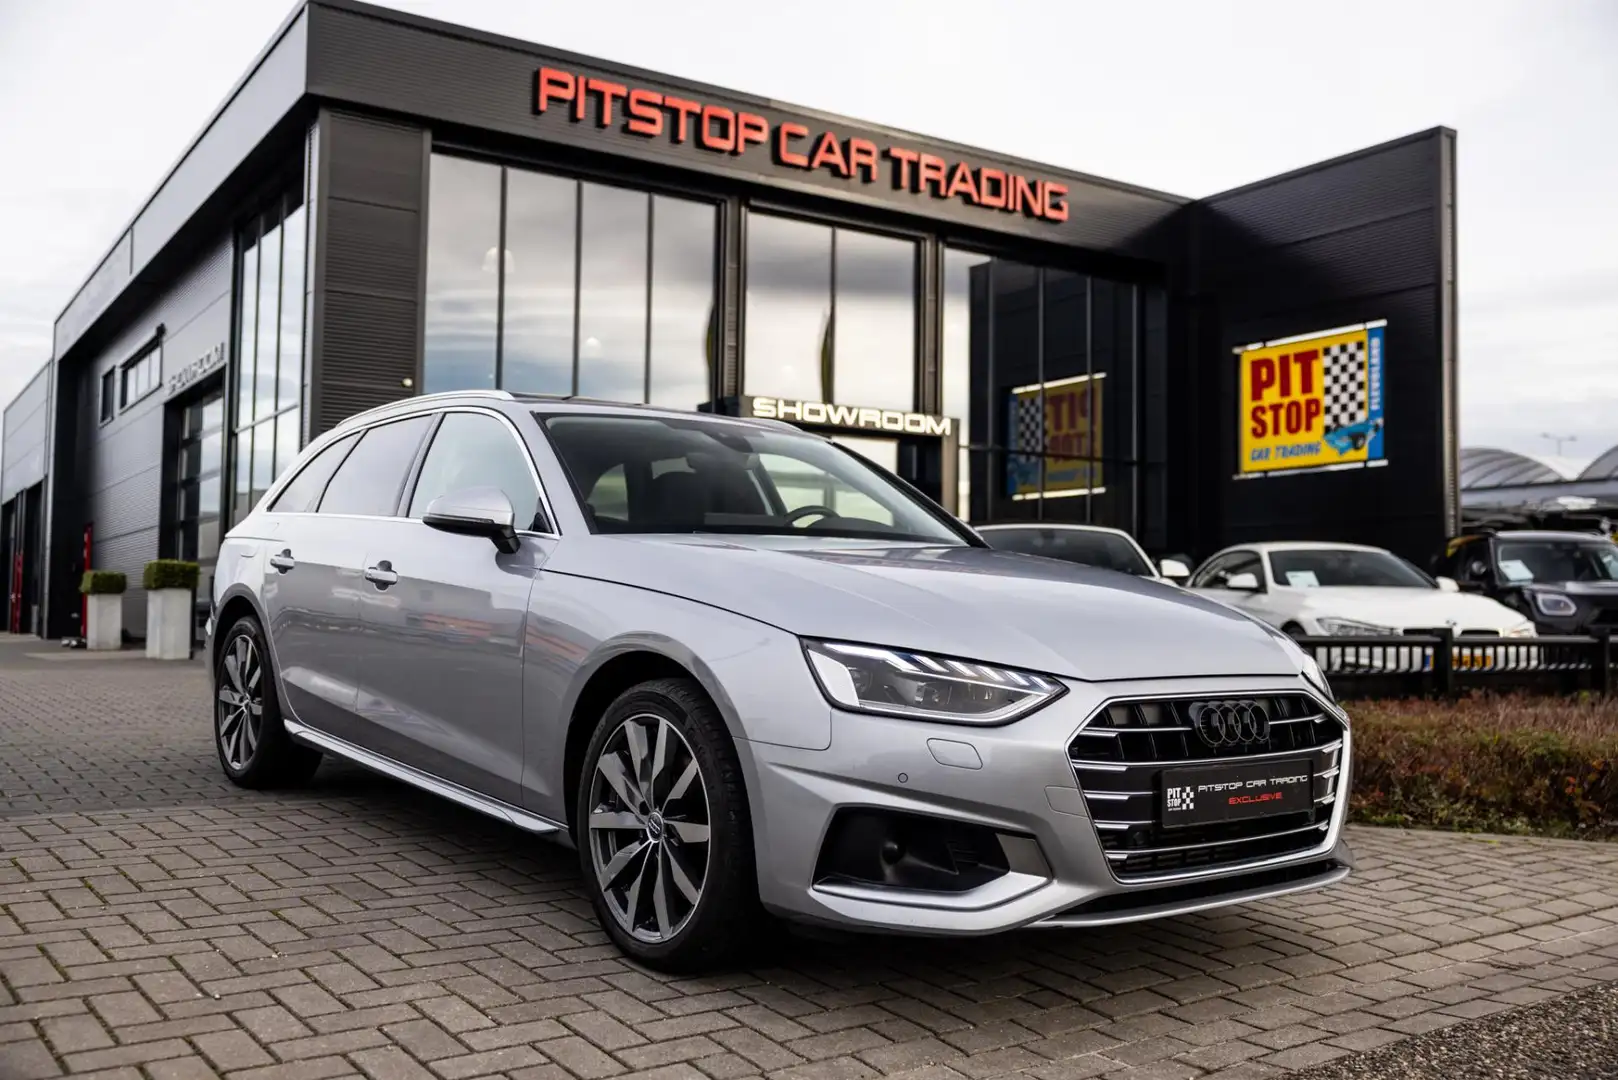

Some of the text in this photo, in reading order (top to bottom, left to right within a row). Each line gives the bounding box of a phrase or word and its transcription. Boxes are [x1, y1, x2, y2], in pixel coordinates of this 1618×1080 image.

[537, 67, 1069, 222] PITSTOP CAR TRADING
[1251, 350, 1319, 402] PIT
[752, 396, 951, 436] SHOWROOM
[1251, 398, 1322, 439] STOP
[1167, 787, 1181, 799] PIT
[1198, 774, 1308, 793] PITSTOP CAR TRADING
[1228, 791, 1283, 805] EXCLUSIVE
[1167, 798, 1181, 808] STOP
